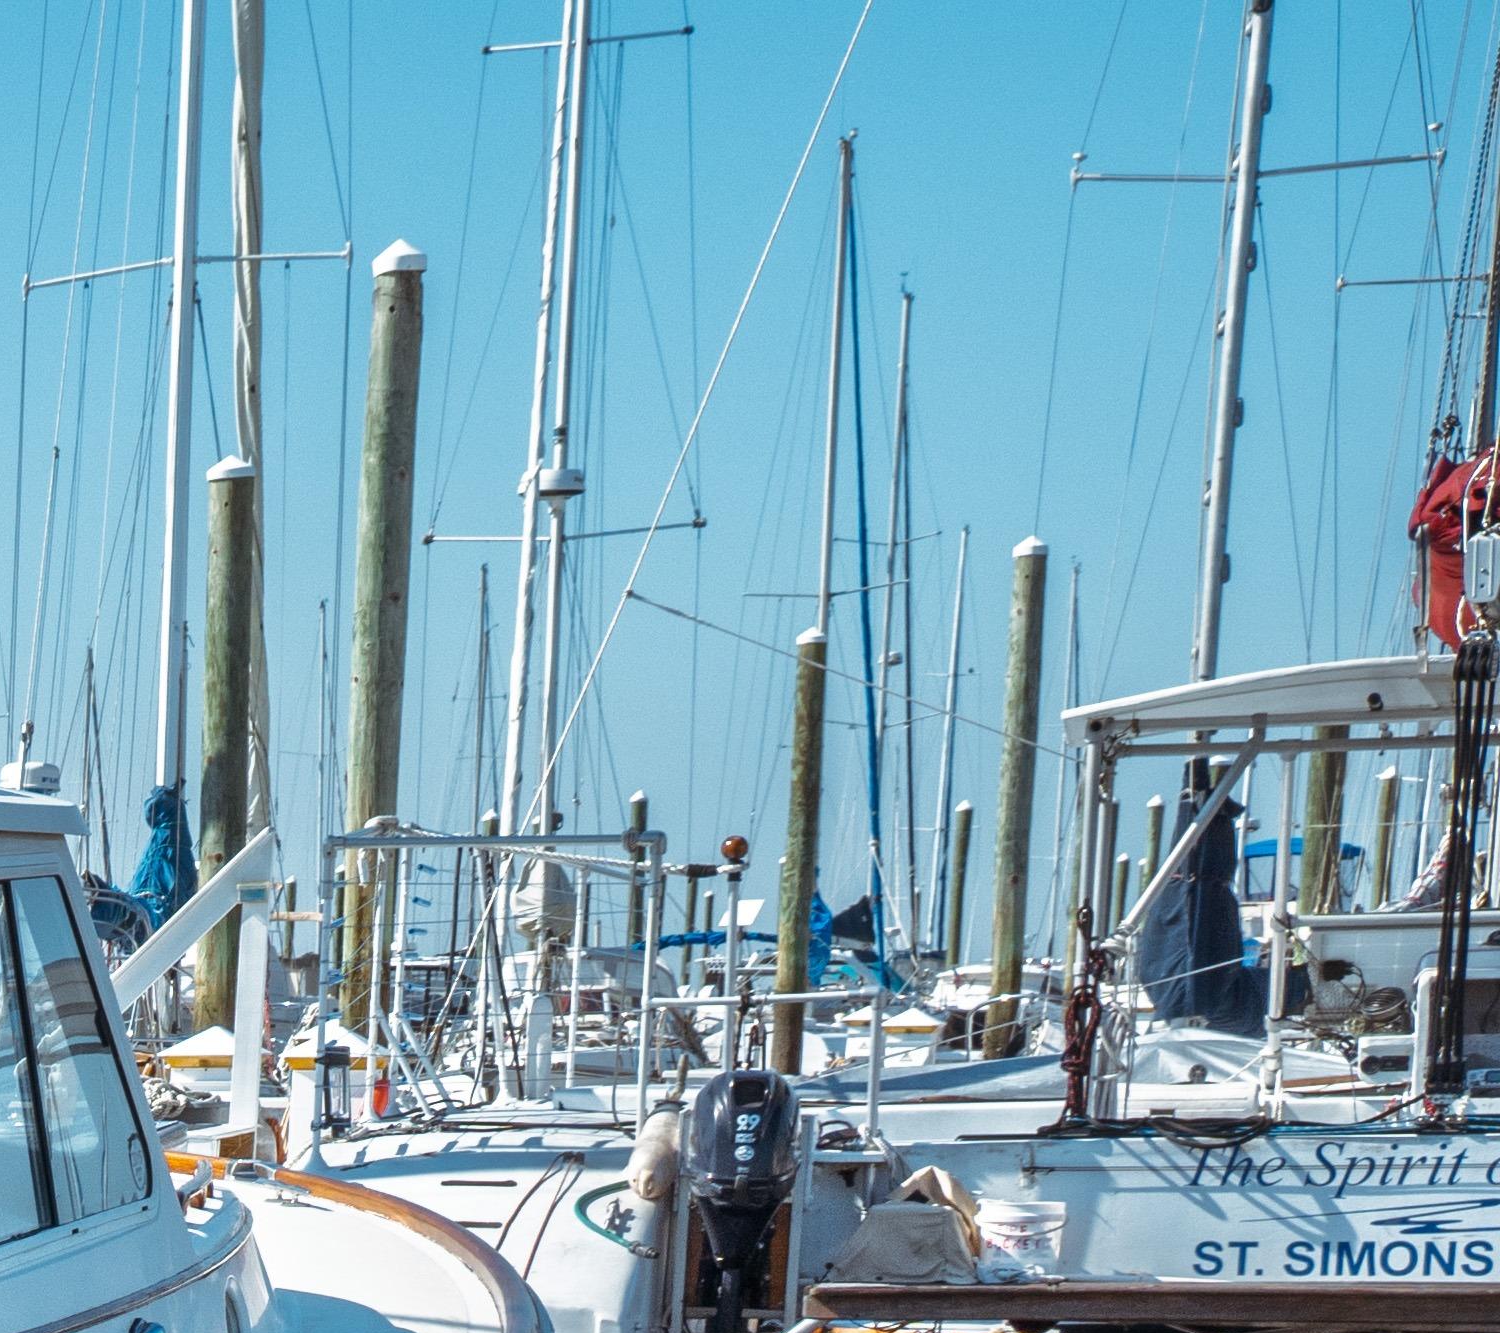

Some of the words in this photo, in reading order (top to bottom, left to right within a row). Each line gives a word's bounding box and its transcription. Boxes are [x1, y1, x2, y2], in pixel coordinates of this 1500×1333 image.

[1186, 1141, 1286, 1187] The
[1303, 1142, 1468, 1199] Spirit
[1193, 1241, 1263, 1277] ST.
[1284, 1240, 1494, 1277] SIMONS
